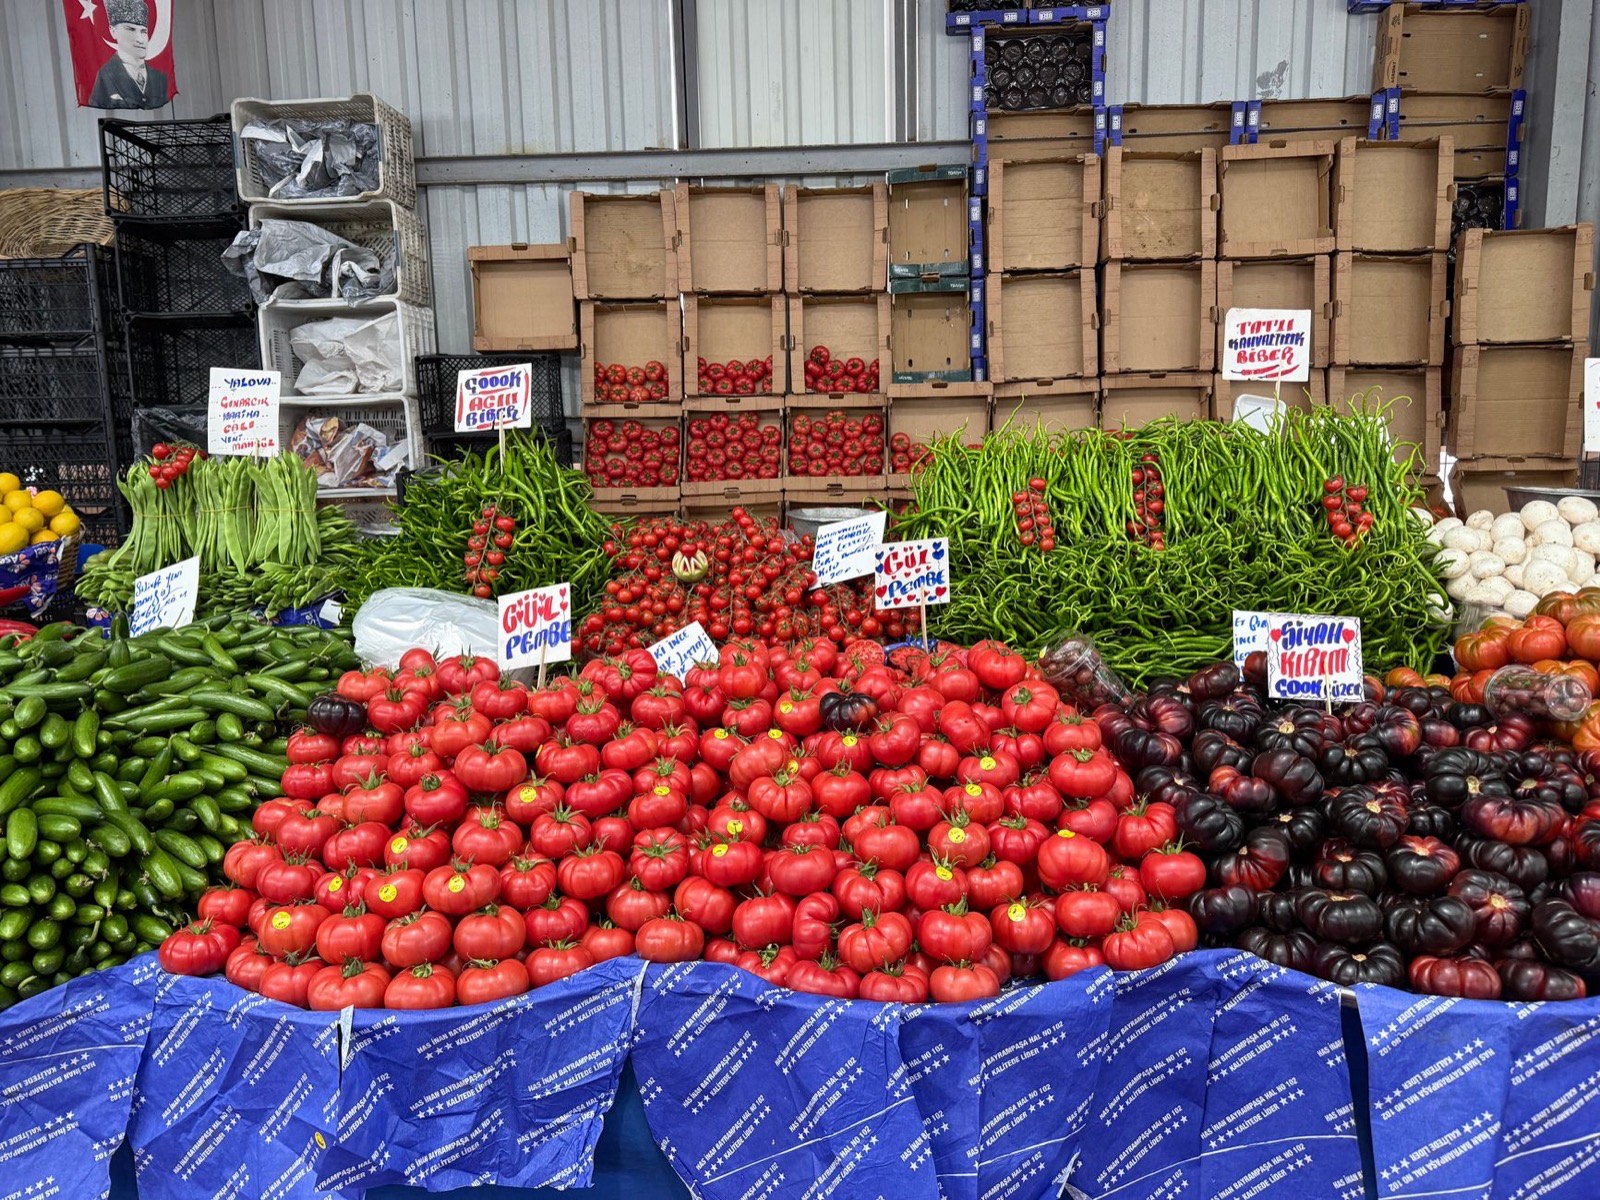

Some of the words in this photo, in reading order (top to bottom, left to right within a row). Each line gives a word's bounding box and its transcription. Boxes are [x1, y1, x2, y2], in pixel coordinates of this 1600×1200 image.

[224, 378, 271, 388] YALOVA
[503, 592, 560, 634] GÜL
[506, 620, 571, 659] PEMBE
[1281, 621, 1344, 650] SİYAH
[382, 1015, 397, 1026] 102
[577, 1002, 605, 1023] KALİTEDE
[606, 995, 624, 1007] LİDER
[904, 1007, 923, 1022] LİDER
[694, 1012, 717, 1036] KALİTEDE
[1126, 1023, 1152, 1044] KALİTEDE
[1151, 1011, 1168, 1024] LİDER
[354, 1038, 373, 1052] LİDER
[985, 1040, 1028, 1066] BAYRAMPAŞA
[1029, 1034, 1042, 1043] HAL
[1042, 1028, 1052, 1036] NO
[1052, 1020, 1064, 1032] 102
[1221, 1033, 1259, 1062] BAYRAMPAŞA
[1258, 1026, 1271, 1037] HAL
[1270, 1020, 1279, 1029] NO
[1279, 1013, 1291, 1025] 102
[81, 1061, 96, 1072] HAS
[908, 1058, 922, 1067] HAL
[920, 1051, 932, 1061] NO
[931, 1043, 945, 1054] 102
[991, 1057, 1020, 1076] KALİTEDE
[1021, 1048, 1039, 1061] LİDER
[1229, 1051, 1257, 1073] KALİTEDE
[1256, 1039, 1273, 1052] LİDER
[1462, 1057, 1482, 1073] İNAN
[1478, 1048, 1496, 1061] HAS
[24, 1066, 57, 1087] KALİTEDE
[64, 1069, 80, 1080] İNAN
[377, 1072, 390, 1083] 102
[528, 1082, 541, 1092] HAS
[542, 1073, 558, 1085] İNAN
[558, 1050, 601, 1075] BAYRAMPAŞA
[601, 1042, 613, 1054] HAL
[563, 1066, 593, 1087] KALİTEDE
[594, 1057, 612, 1072] LİDER
[709, 1072, 731, 1096] KALİTEDE
[729, 1059, 744, 1077] LİDER
[826, 1076, 839, 1089] HAL
[835, 1067, 846, 1077] NO
[845, 1056, 857, 1069] 102
[1421, 1056, 1453, 1078] KALİTEDE
[409, 1100, 424, 1112] HAS
[424, 1092, 439, 1102] İNAN
[441, 1071, 482, 1096] BAYRAMPAŞA
[1125, 1083, 1149, 1106] KALİTEDE
[1148, 1074, 1165, 1087] LİDER
[1402, 1073, 1423, 1090] LİDER
[1417, 1068, 1464, 1098] BAYRAMPAŞA
[110, 1092, 122, 1102] 102
[826, 1091, 842, 1108] LİDER
[1394, 1102, 1406, 1112] NO
[1404, 1093, 1419, 1105] HAL
[1550, 1088, 1578, 1112] KALİTEDE
[931, 1110, 945, 1122] 102
[1235, 1112, 1263, 1134] KALİTEDE
[1262, 1103, 1280, 1117] LİDER
[1380, 1108, 1395, 1120] 102
[1531, 1108, 1551, 1123] LİDER
[9, 1125, 42, 1146] KALİTEDE
[49, 1128, 66, 1140] İNAN
[516, 1134, 530, 1145] HAS
[695, 1159, 706, 1171] HAS
[705, 1148, 717, 1160] İNAN
[715, 1121, 744, 1151] BAYRAMPAŞA
[742, 1110, 752, 1124] HAL
[750, 1102, 758, 1112] NO
[756, 1095, 765, 1106] 102
[985, 1122, 1011, 1147] KALİTEDE
[1011, 1111, 1028, 1127] LİDER
[1429, 1128, 1462, 1152] KALİTEDE
[723, 1138, 745, 1159] KALİTEDE
[742, 1124, 754, 1141] LİDER
[839, 1144, 852, 1158] HAL
[850, 1136, 861, 1147] NO
[859, 1125, 872, 1138] 102
[900, 1150, 911, 1162] HAS
[909, 1138, 923, 1151] İNAN
[1125, 1146, 1149, 1171] KALİTEDE
[1148, 1133, 1164, 1149] LİDER
[1409, 1145, 1431, 1162] LİDER
[344, 1172, 366, 1184] LİDER
[1233, 1162, 1273, 1190] BAYRAMPAŞA
[1272, 1155, 1285, 1165] HAL
[1283, 1149, 1294, 1159] NO
[1293, 1143, 1306, 1153] 102
[1543, 1156, 1575, 1178] KALİTEDE
[1242, 1178, 1270, 1200] KALİTEDE
[1269, 1169, 1287, 1182] LİDER
[1524, 1174, 1545, 1189] LİDER
